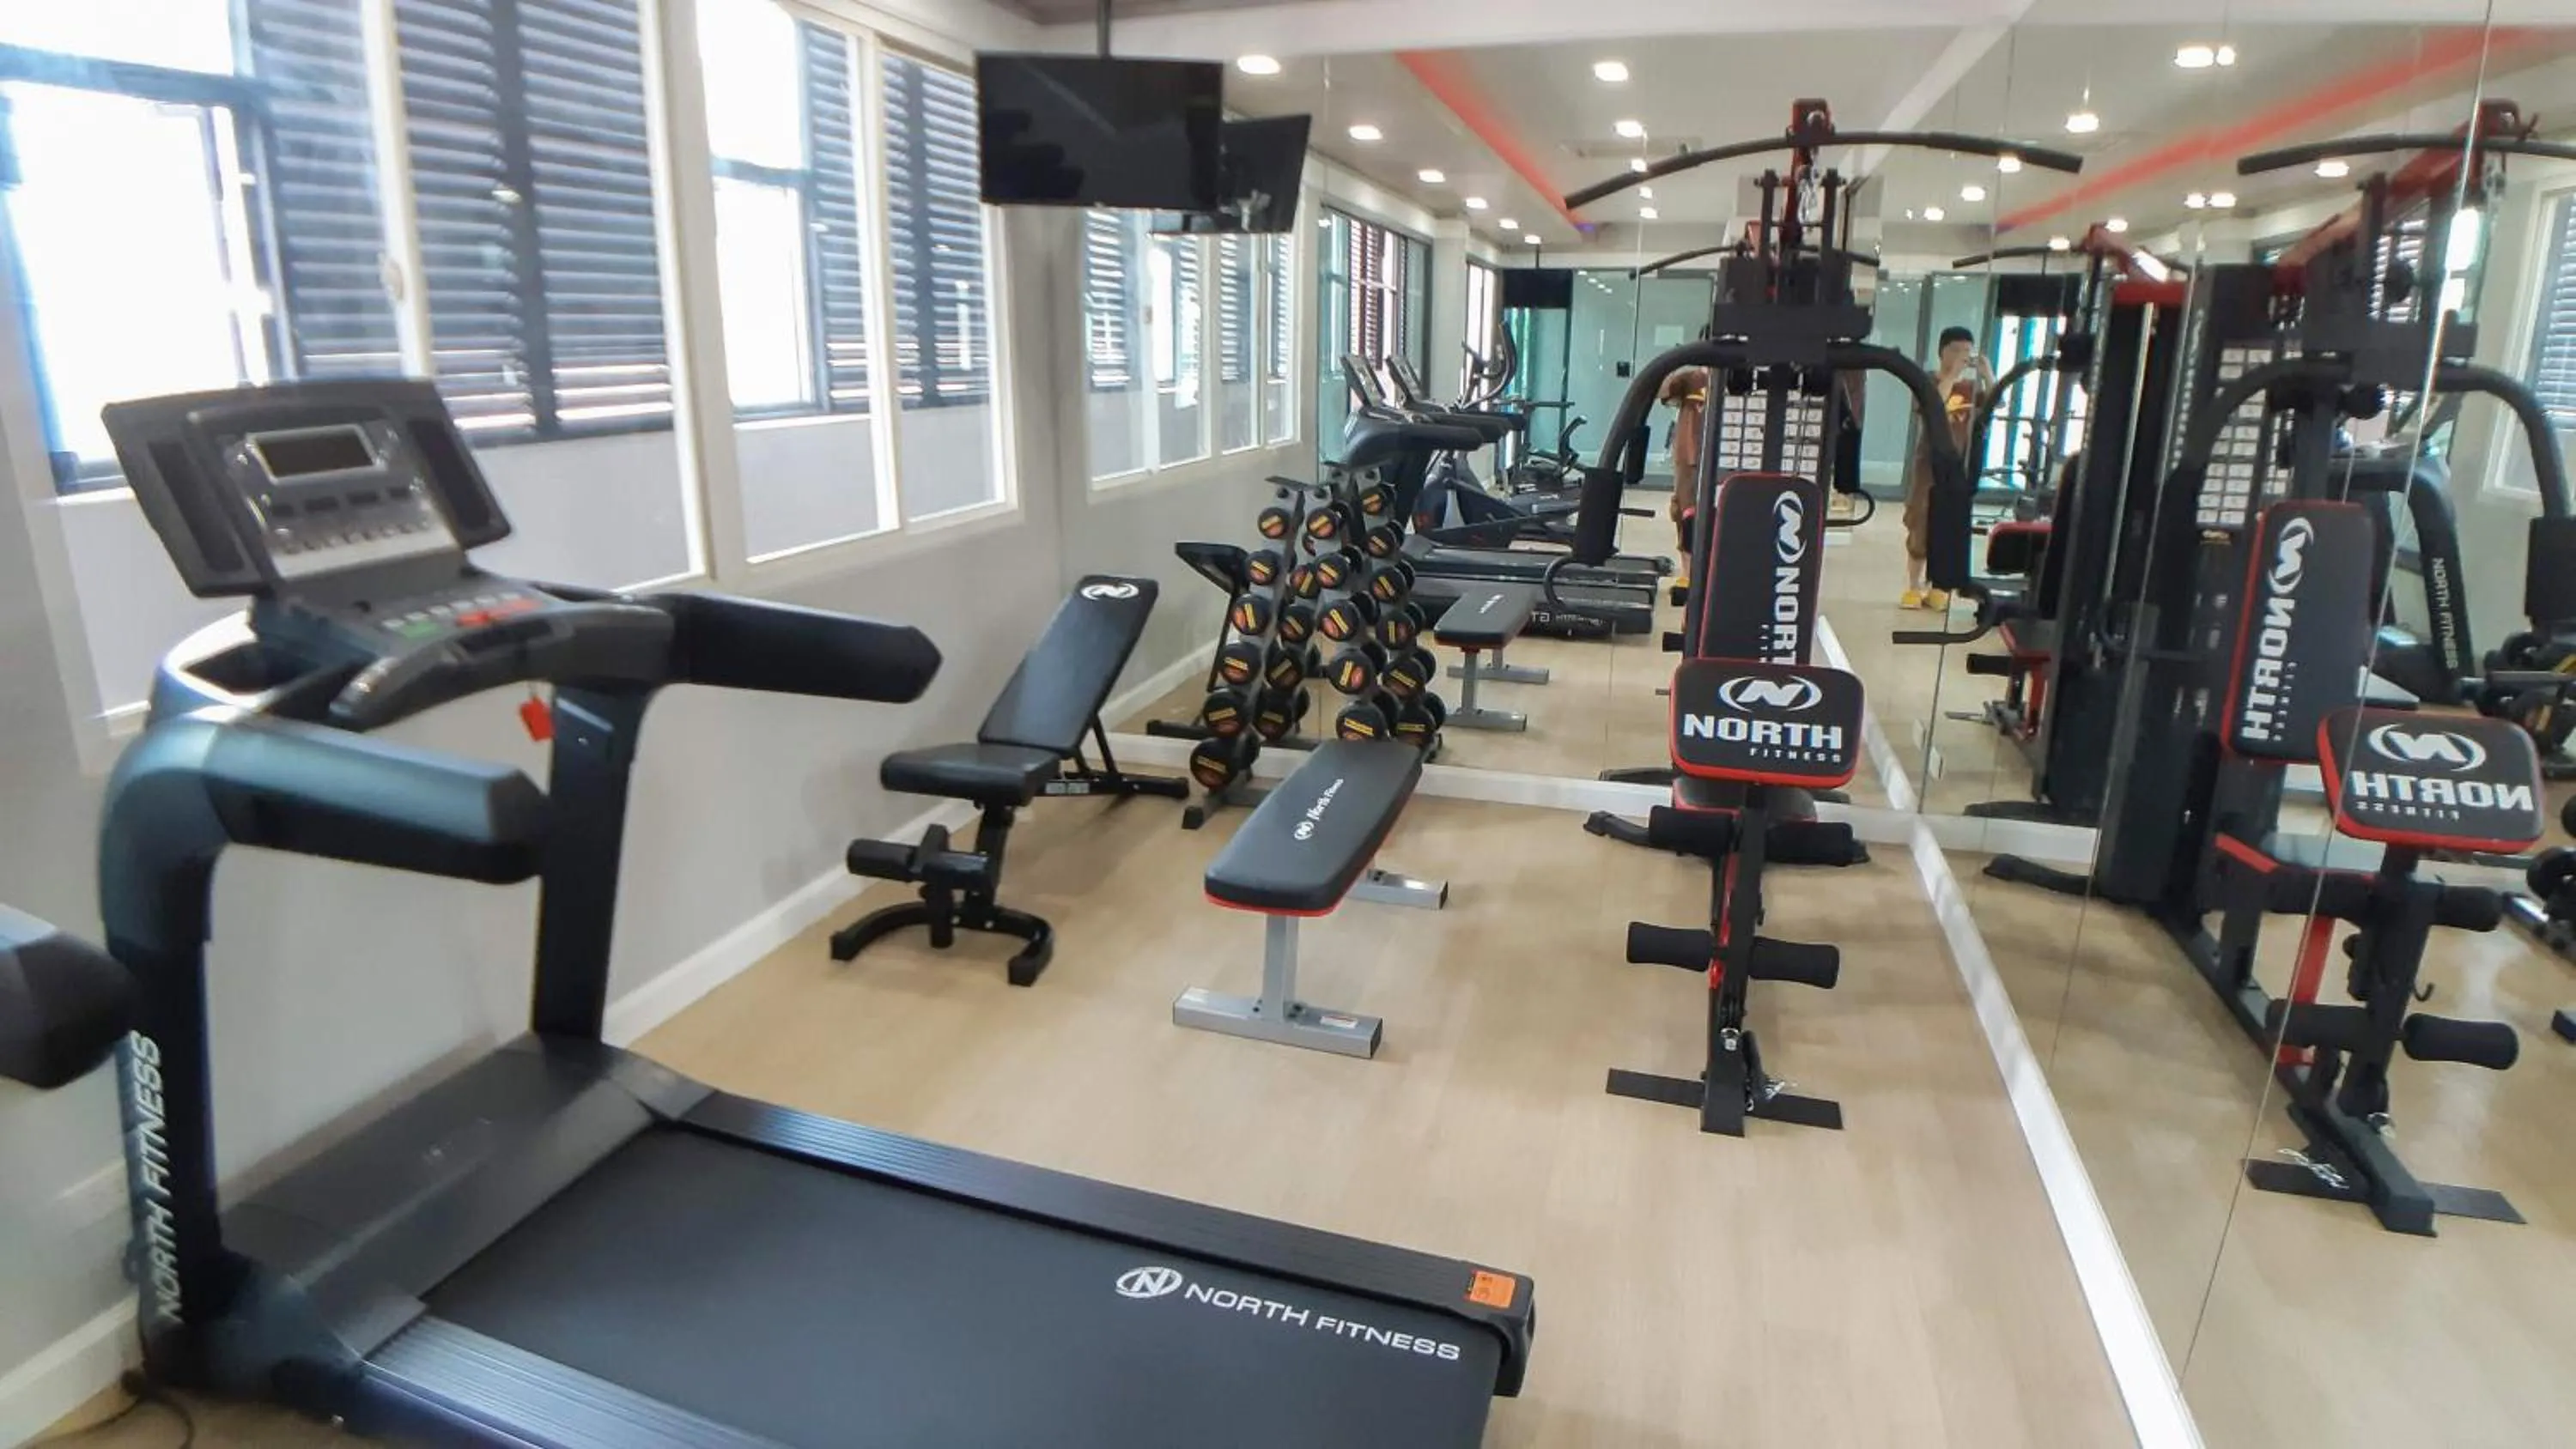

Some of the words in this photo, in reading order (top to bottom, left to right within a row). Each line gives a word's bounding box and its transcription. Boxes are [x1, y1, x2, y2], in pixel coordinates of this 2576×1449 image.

[1759, 624, 1769, 664] FITN
[1772, 567, 1801, 665] NORT
[1683, 713, 1843, 749] NORTH
[1749, 747, 1841, 762] FITNESS
[130, 1029, 171, 1197] FITNESS
[144, 1197, 183, 1324] NORTH
[1184, 1282, 1310, 1326] NORTH
[1315, 1315, 1461, 1361] FITNESS
